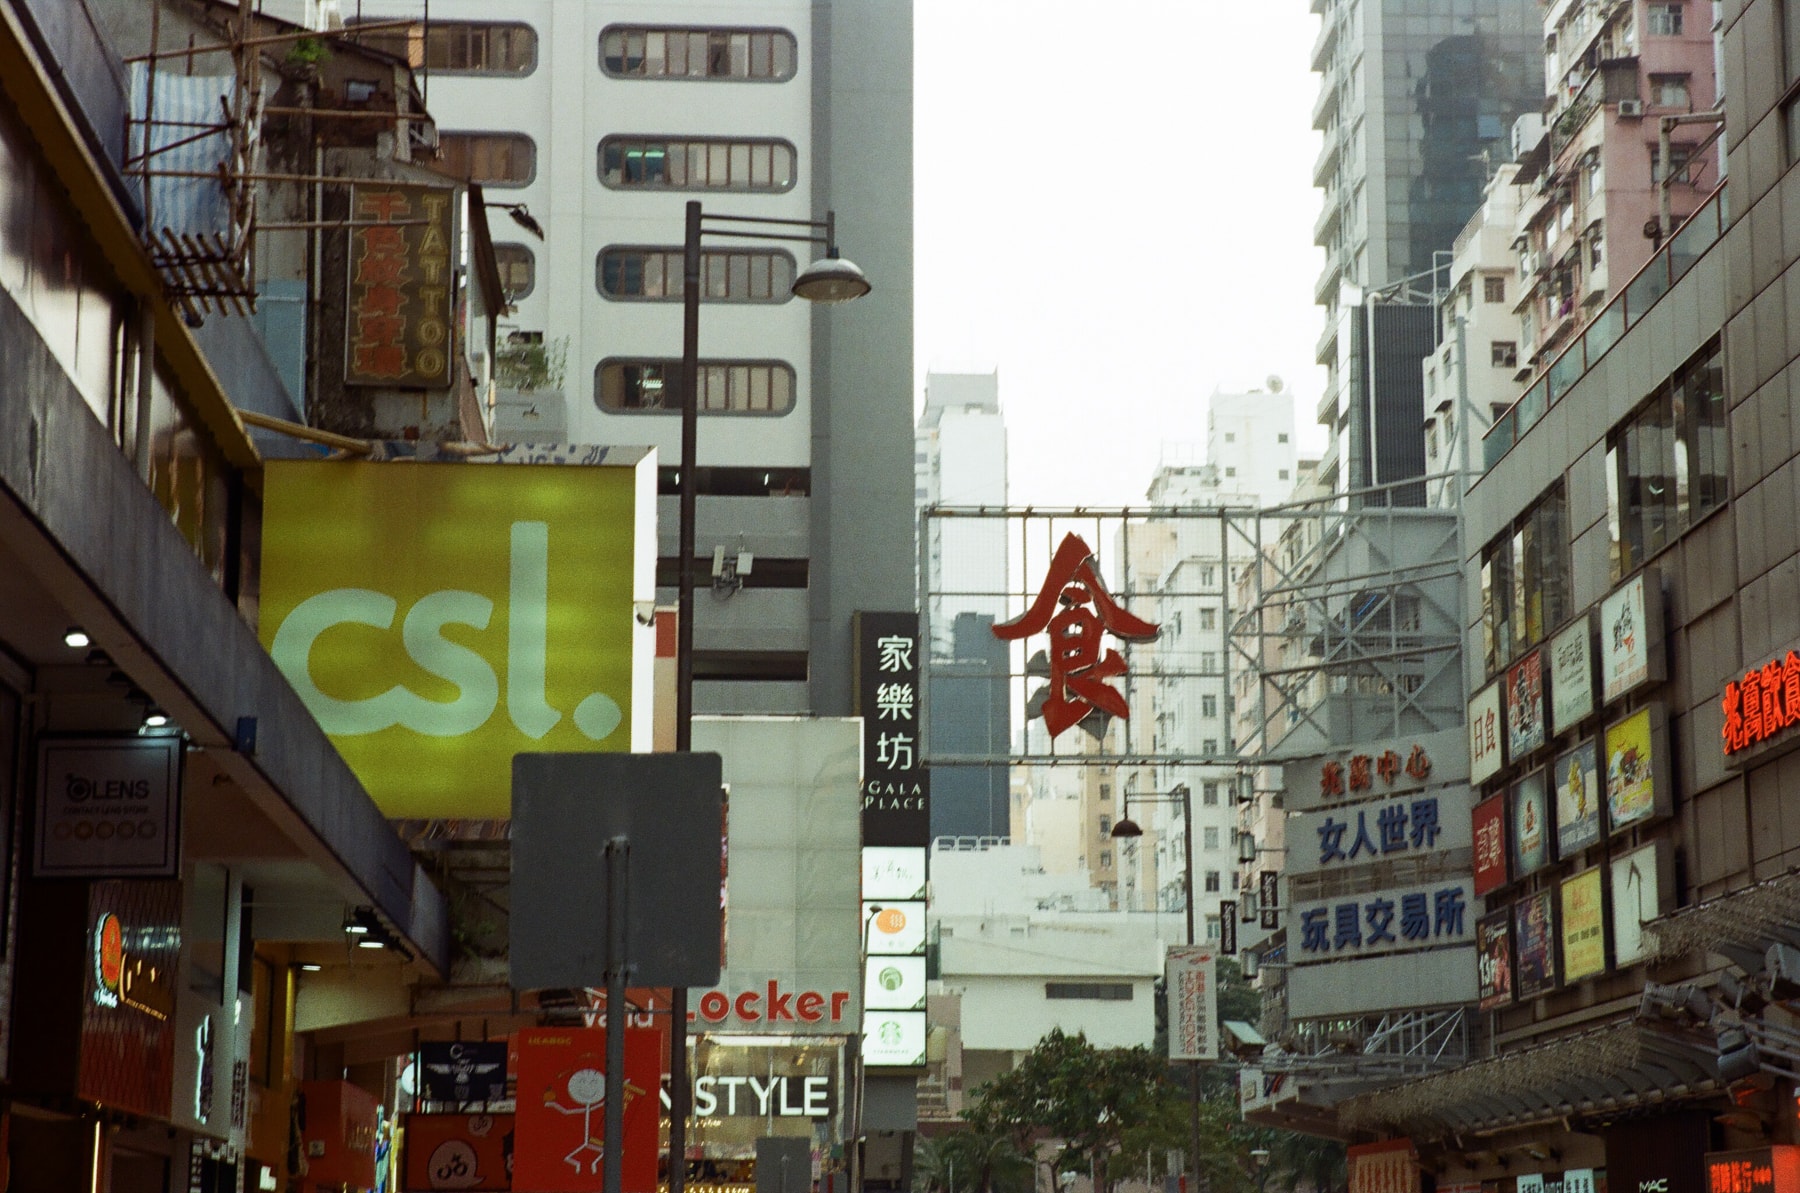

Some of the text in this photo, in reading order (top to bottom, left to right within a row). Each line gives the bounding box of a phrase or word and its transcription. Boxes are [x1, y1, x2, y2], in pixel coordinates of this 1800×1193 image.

[416, 193, 448, 379] TATTOO
[270, 520, 622, 741] csl.
[991, 530, 1163, 741] 食
[876, 634, 914, 770] 家樂坊
[868, 780, 922, 796] GALA
[1319, 743, 1432, 796] 兆萬中心
[864, 796, 926, 811] PLACE
[1316, 797, 1441, 865] 女人世界
[1301, 886, 1466, 951] 玩具交易所
[695, 1075, 829, 1117] STYLE
